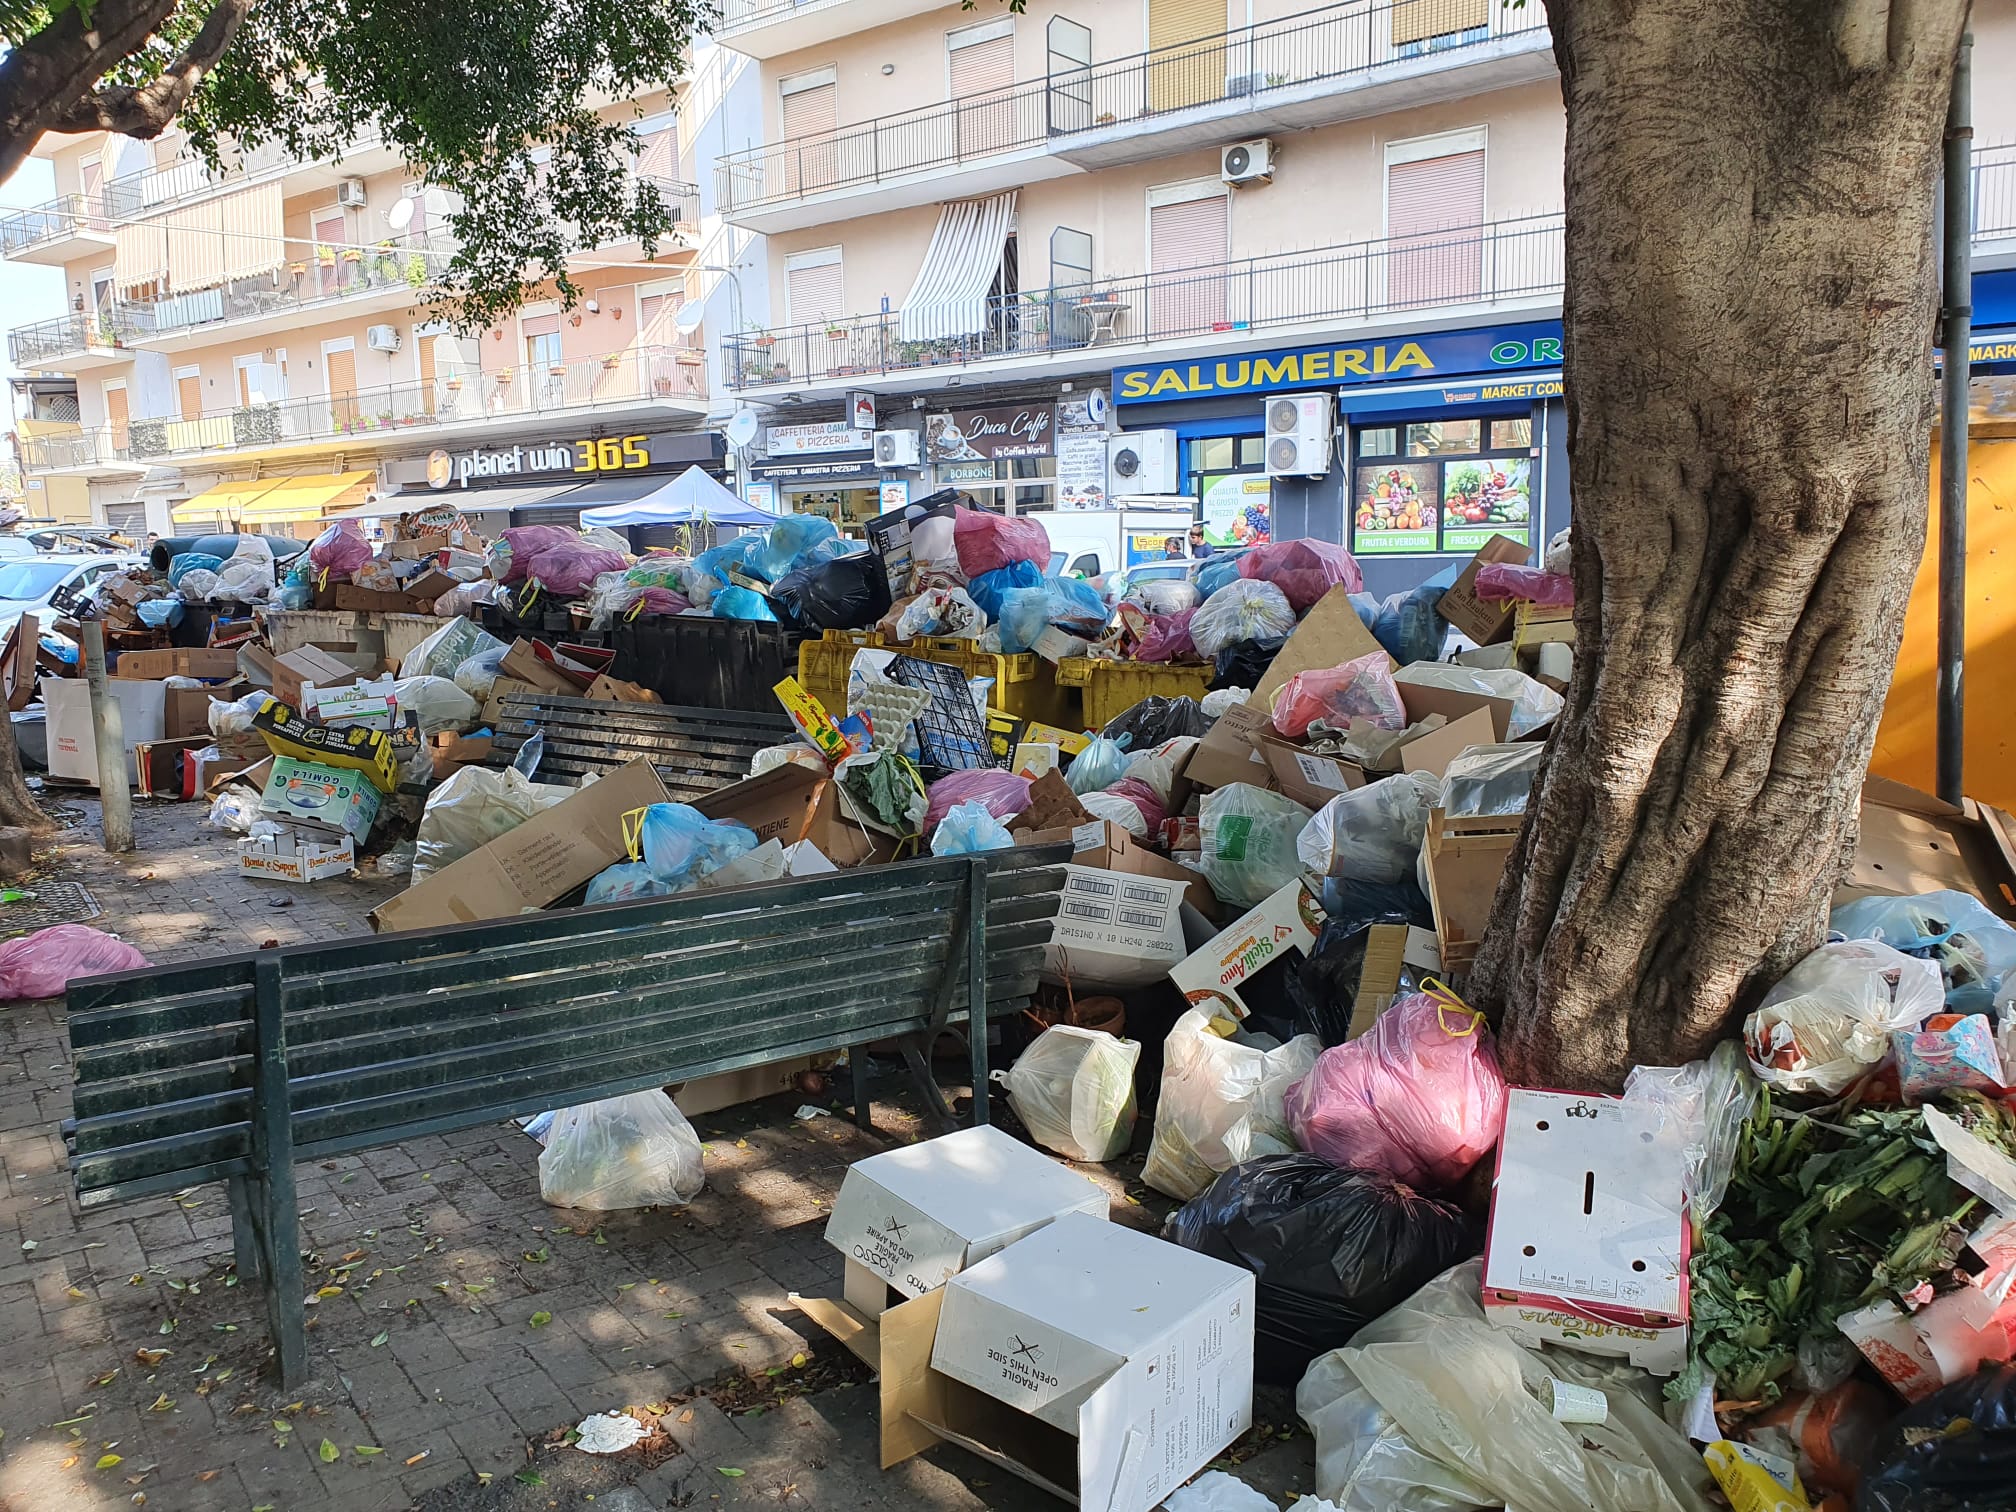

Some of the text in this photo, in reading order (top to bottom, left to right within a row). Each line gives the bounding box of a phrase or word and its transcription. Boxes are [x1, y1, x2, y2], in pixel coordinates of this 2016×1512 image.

[1121, 342, 1434, 398] SALUMERIA
[1482, 384, 1534, 399] MARKET
[774, 426, 824, 438] CAFFETTERIA
[965, 415, 1008, 440] Duca
[1062, 426, 1082, 434] Vendita
[808, 435, 850, 447] PIZZERIA
[996, 445, 1046, 457] by Coffee World
[460, 435, 650, 488] planet win 365
[764, 464, 861, 477] CAFFETTERIA CAMASTRA PIZZERIA
[950, 466, 993, 479] BORBONE
[1138, 538, 1165, 548] SCOR
[1361, 536, 1430, 547] FRUTTA E VERDURA
[1451, 535, 1480, 545] FRESCA
[1453, 588, 1467, 601] Pan
[1466, 597, 1495, 625] Bauletto
[272, 722, 300, 738] PINEAPPLES
[286, 723, 303, 733] SWEET
[289, 719, 305, 729] EXTRA
[326, 736, 344, 744] SWEET
[328, 731, 345, 739] EXTRA
[325, 740, 356, 751] PINEAPPLES
[293, 769, 340, 785] GOMILA
[358, 785, 377, 808] GOMILA
[753, 817, 790, 837] NTIENE
[332, 850, 351, 862] Sapori
[272, 859, 298, 872] Sapori
[1097, 931, 1102, 940] X
[1220, 936, 1274, 985] SiciliAmo
[866, 1225, 914, 1263] LATO DA APRIRE
[874, 1242, 900, 1264] FRAGILE
[987, 1348, 1058, 1387] OPEN THIS SIDE
[1002, 1368, 1039, 1392] FRAGILE
